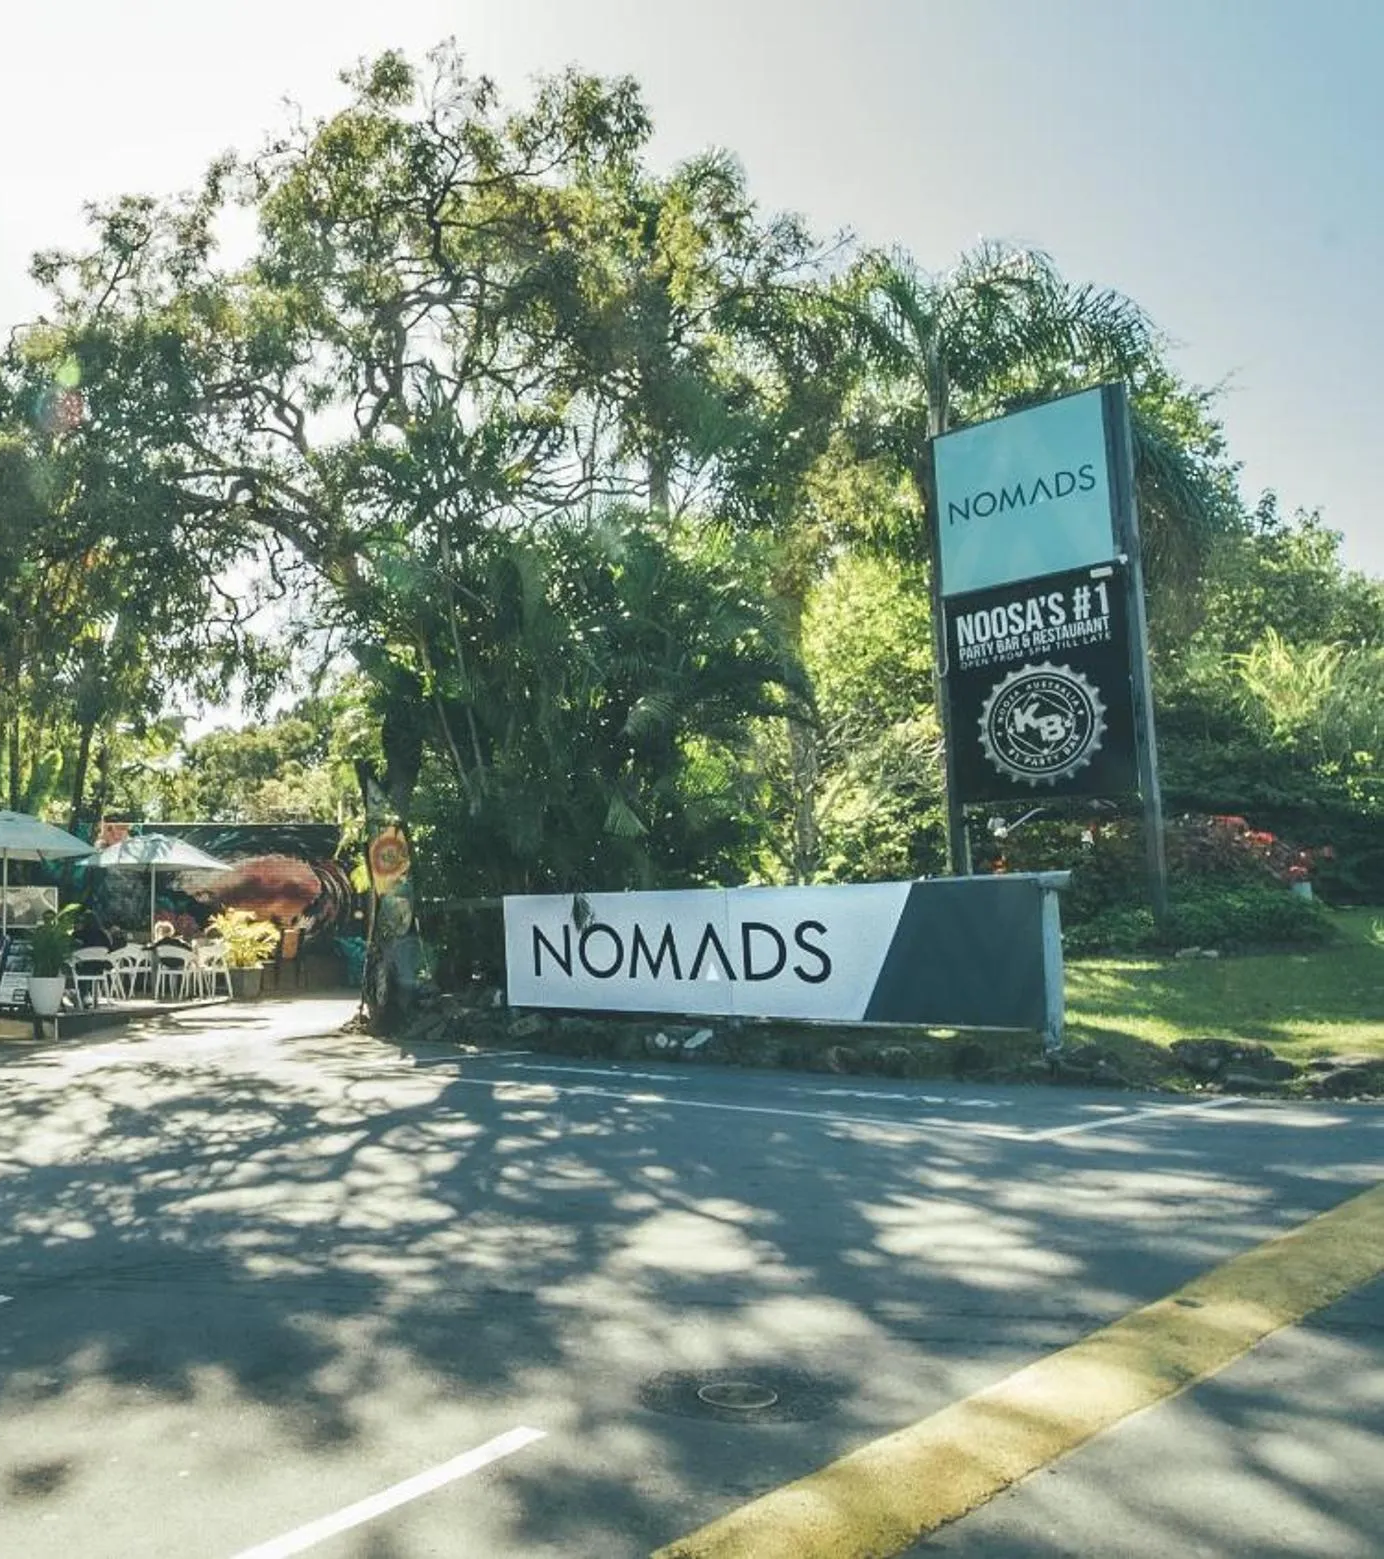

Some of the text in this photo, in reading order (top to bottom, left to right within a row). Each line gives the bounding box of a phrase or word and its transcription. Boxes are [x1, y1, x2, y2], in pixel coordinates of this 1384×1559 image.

[948, 464, 1096, 525] NOMADS
[956, 581, 1110, 647] NOOSA'S #1
[959, 615, 1110, 661] PARTY BAR & RESTAURANT
[960, 655, 989, 670] OPEN
[1055, 640, 1078, 650] TILL
[1083, 632, 1112, 645] LATE
[1014, 702, 1066, 741] KB
[532, 920, 833, 984] NOMADS
